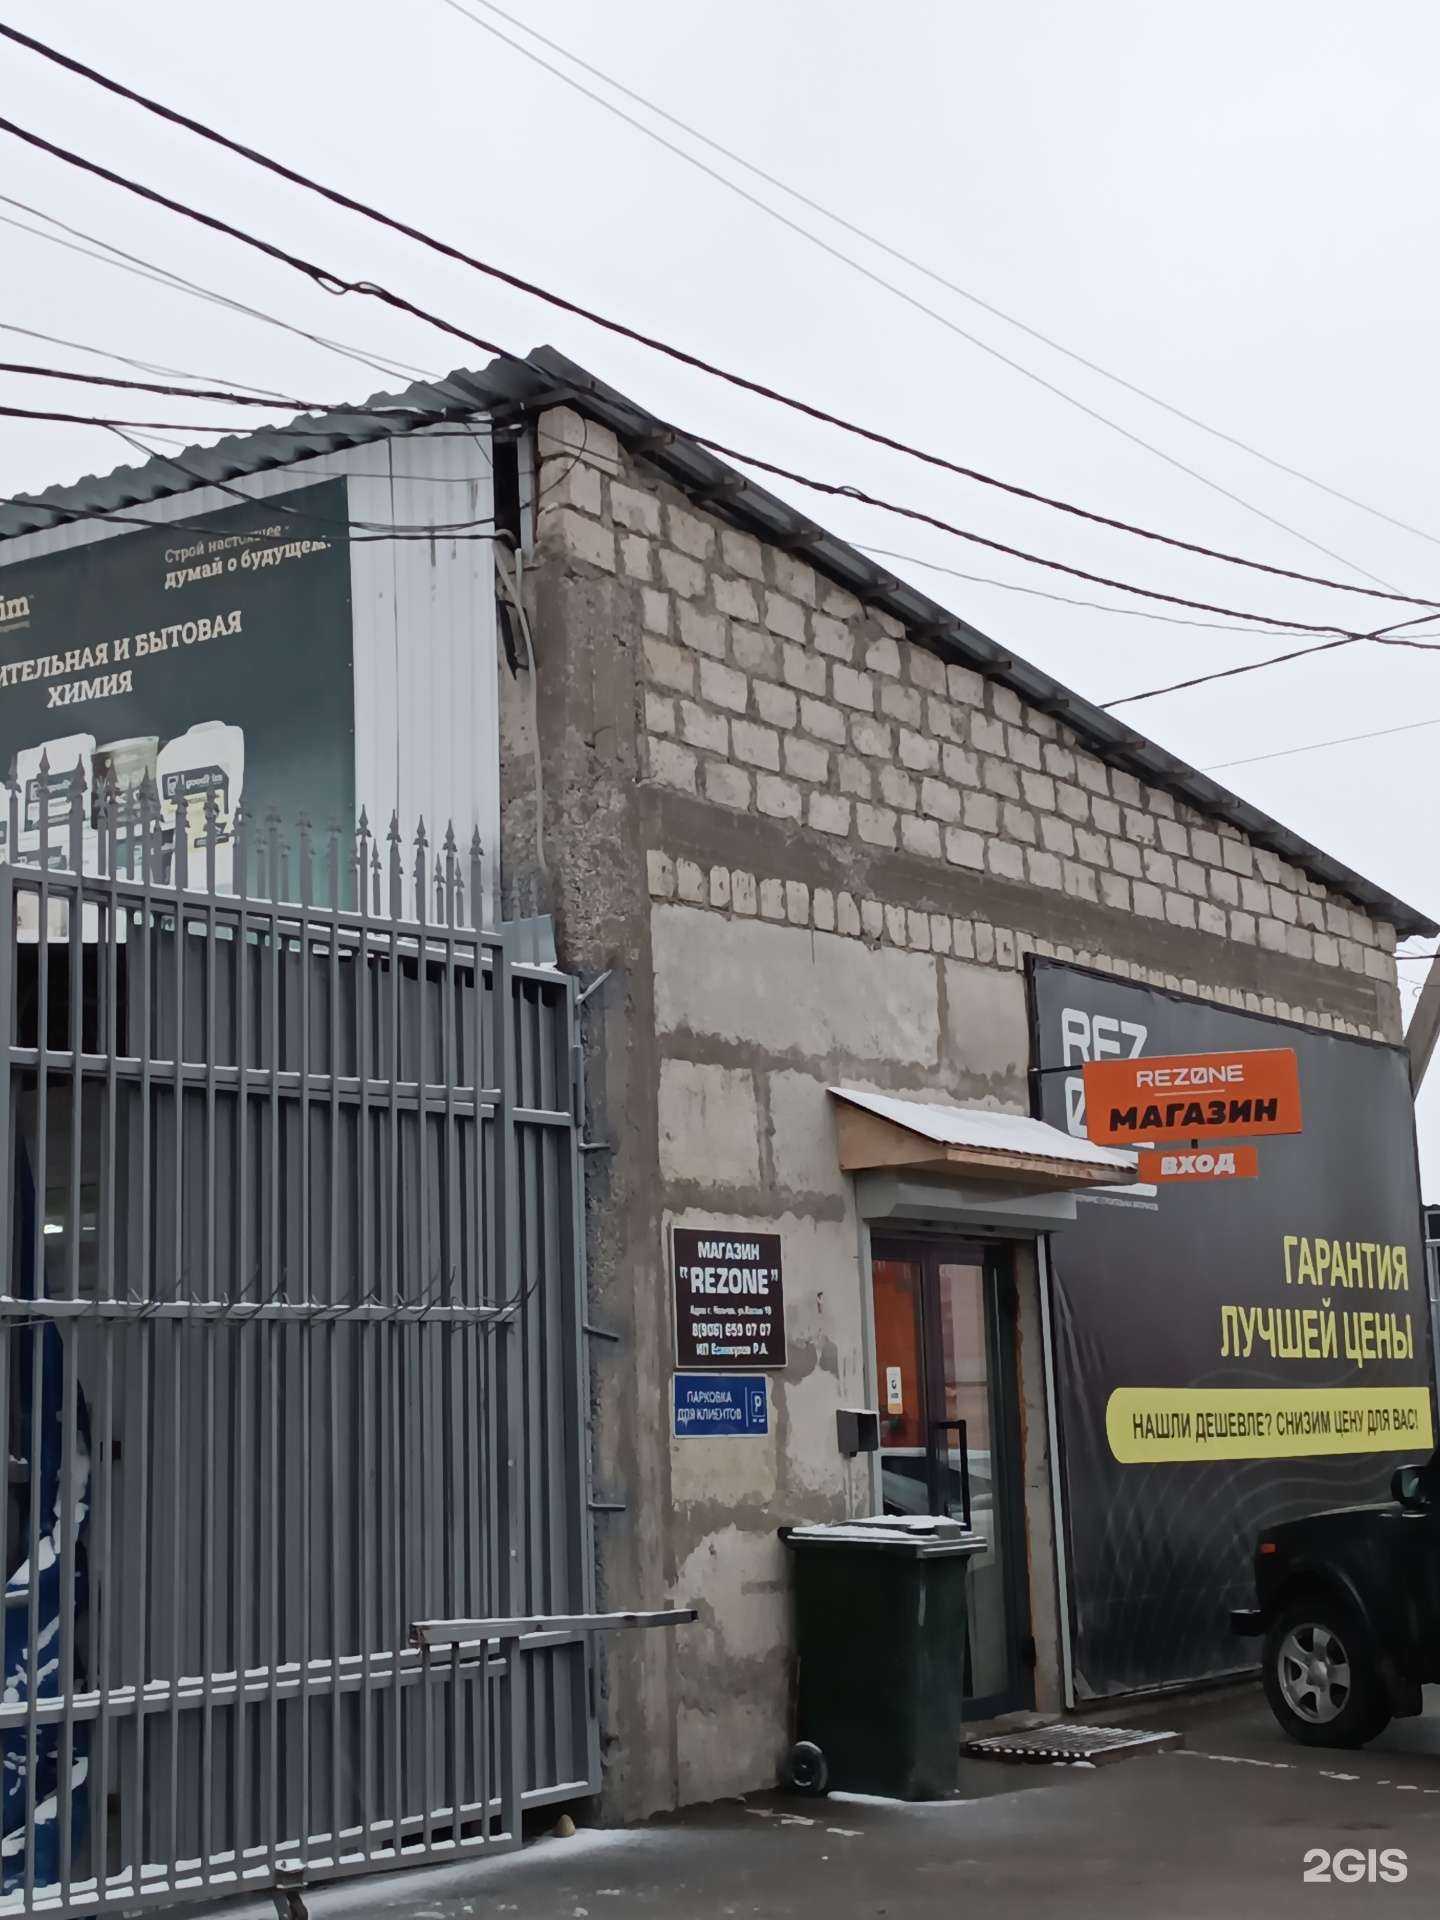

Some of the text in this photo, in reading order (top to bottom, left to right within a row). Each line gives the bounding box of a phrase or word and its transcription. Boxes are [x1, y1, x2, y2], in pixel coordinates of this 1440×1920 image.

[165, 541, 204, 563] Строй
[165, 557, 223, 590] думай
[228, 558, 237, 572] о
[114, 638, 132, 661] И
[135, 610, 242, 657] БЫТОВАЯ
[46, 670, 133, 709] ХИМИЯ
[1110, 1098, 1278, 1132] МАГАЗИН
[1161, 1153, 1236, 1175] ВХОД
[697, 1241, 760, 1261] МАГАЗИН
[1283, 1235, 1409, 1291] ГАРАНТИЯ
[1221, 1297, 1414, 1369] ЛУЧШЕЙ ЦЕНЫ
[687, 1390, 732, 1403] ПАРКОВКА
[677, 1407, 742, 1426] ДЛЯ КЛИЕНТОВ
[1132, 1408, 1419, 1443] НАШЛИ ДЕШЕВЛЕ? СНИЗИМ ЦЕНУ ДЛЯ ВАС!
